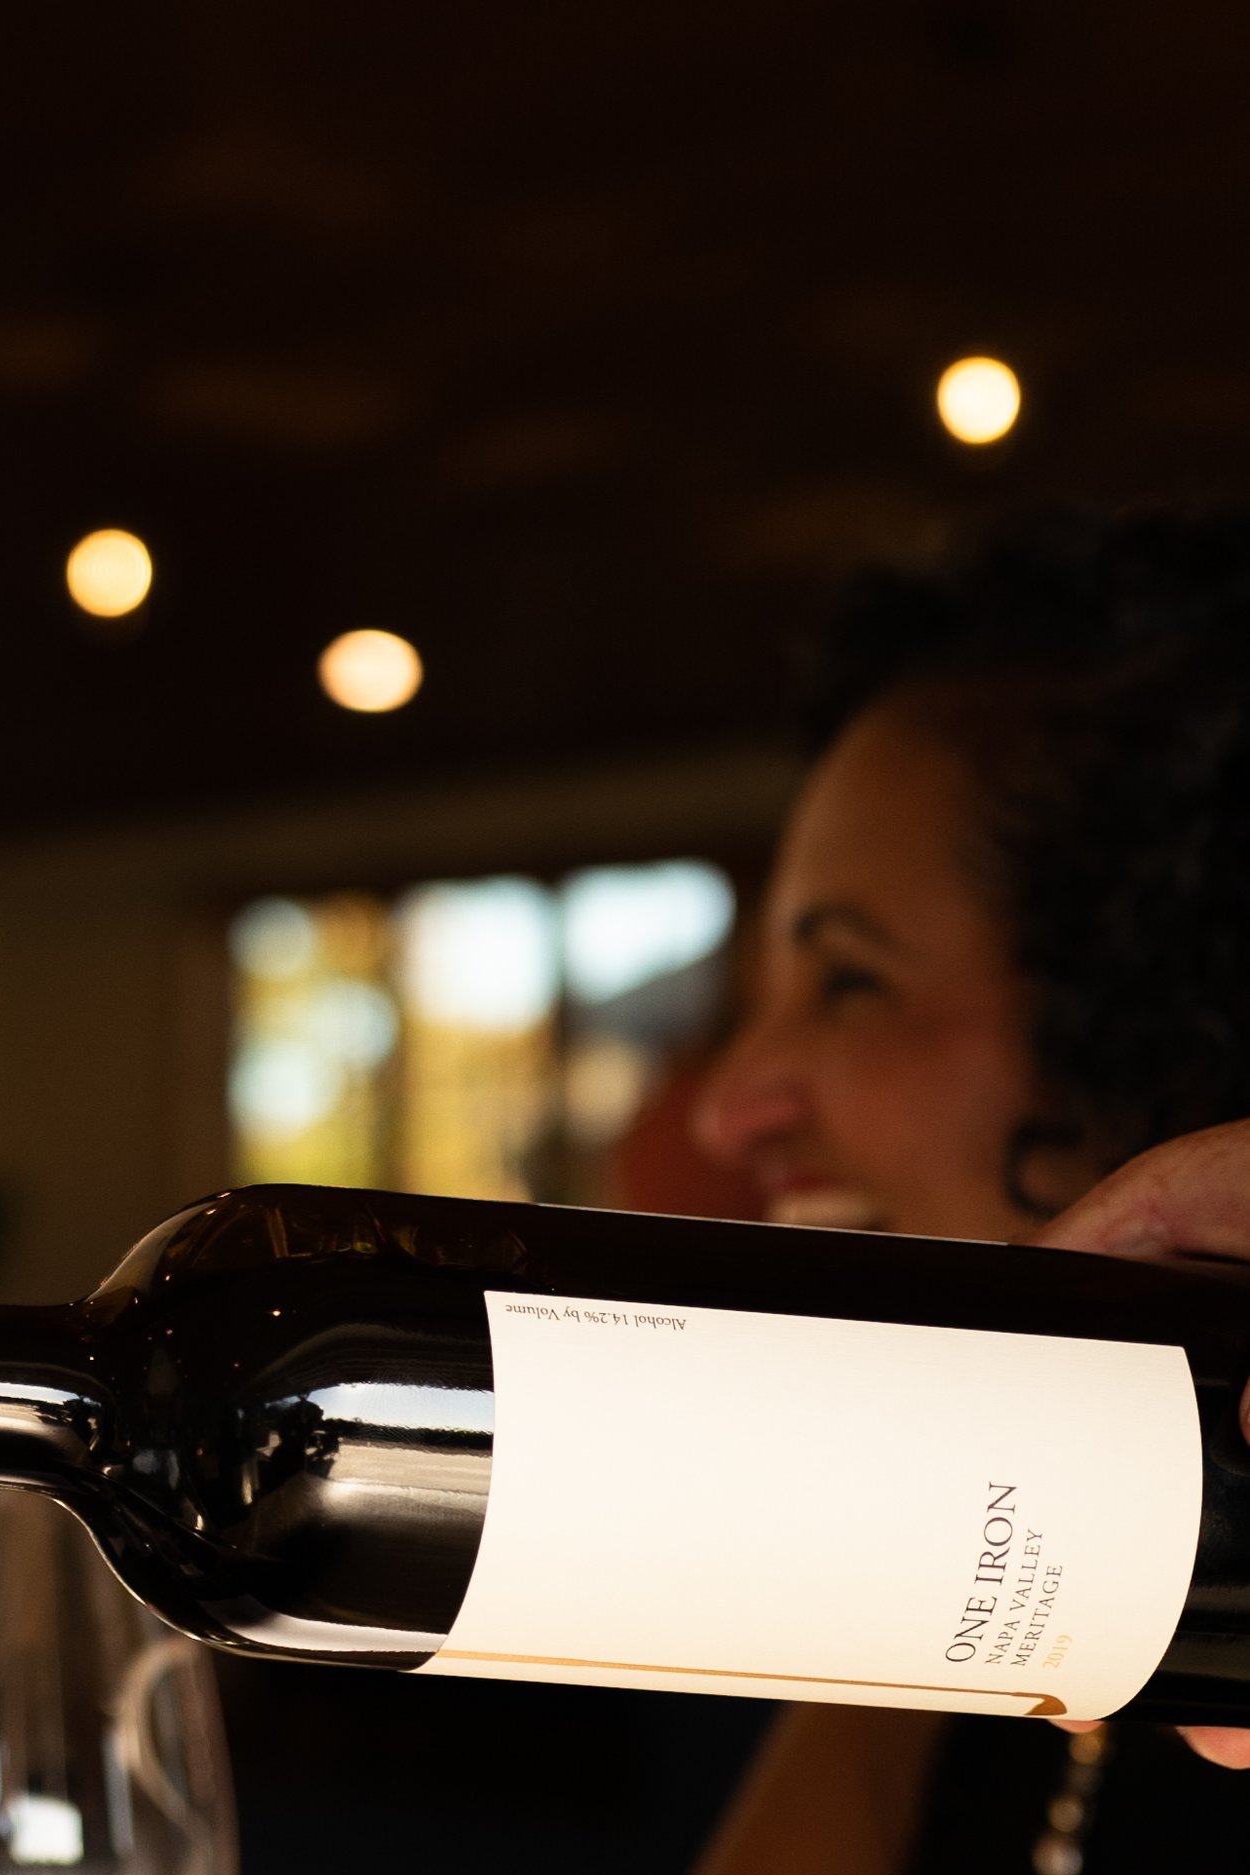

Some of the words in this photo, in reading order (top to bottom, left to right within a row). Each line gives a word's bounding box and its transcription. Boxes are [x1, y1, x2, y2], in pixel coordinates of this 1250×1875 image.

[505, 1304, 560, 1321] Volume
[563, 1306, 581, 1323] by
[584, 1311, 629, 1326] 14.2%
[635, 1315, 687, 1330] Alcohol
[945, 1596, 998, 1663] ONE
[974, 1481, 1017, 1586] IRON
[984, 1620, 1021, 1665] NAPA
[1009, 1528, 1043, 1612] VALLEY
[1010, 1565, 1063, 1666] MERITAGE
[1042, 1634, 1073, 1669] 2019
